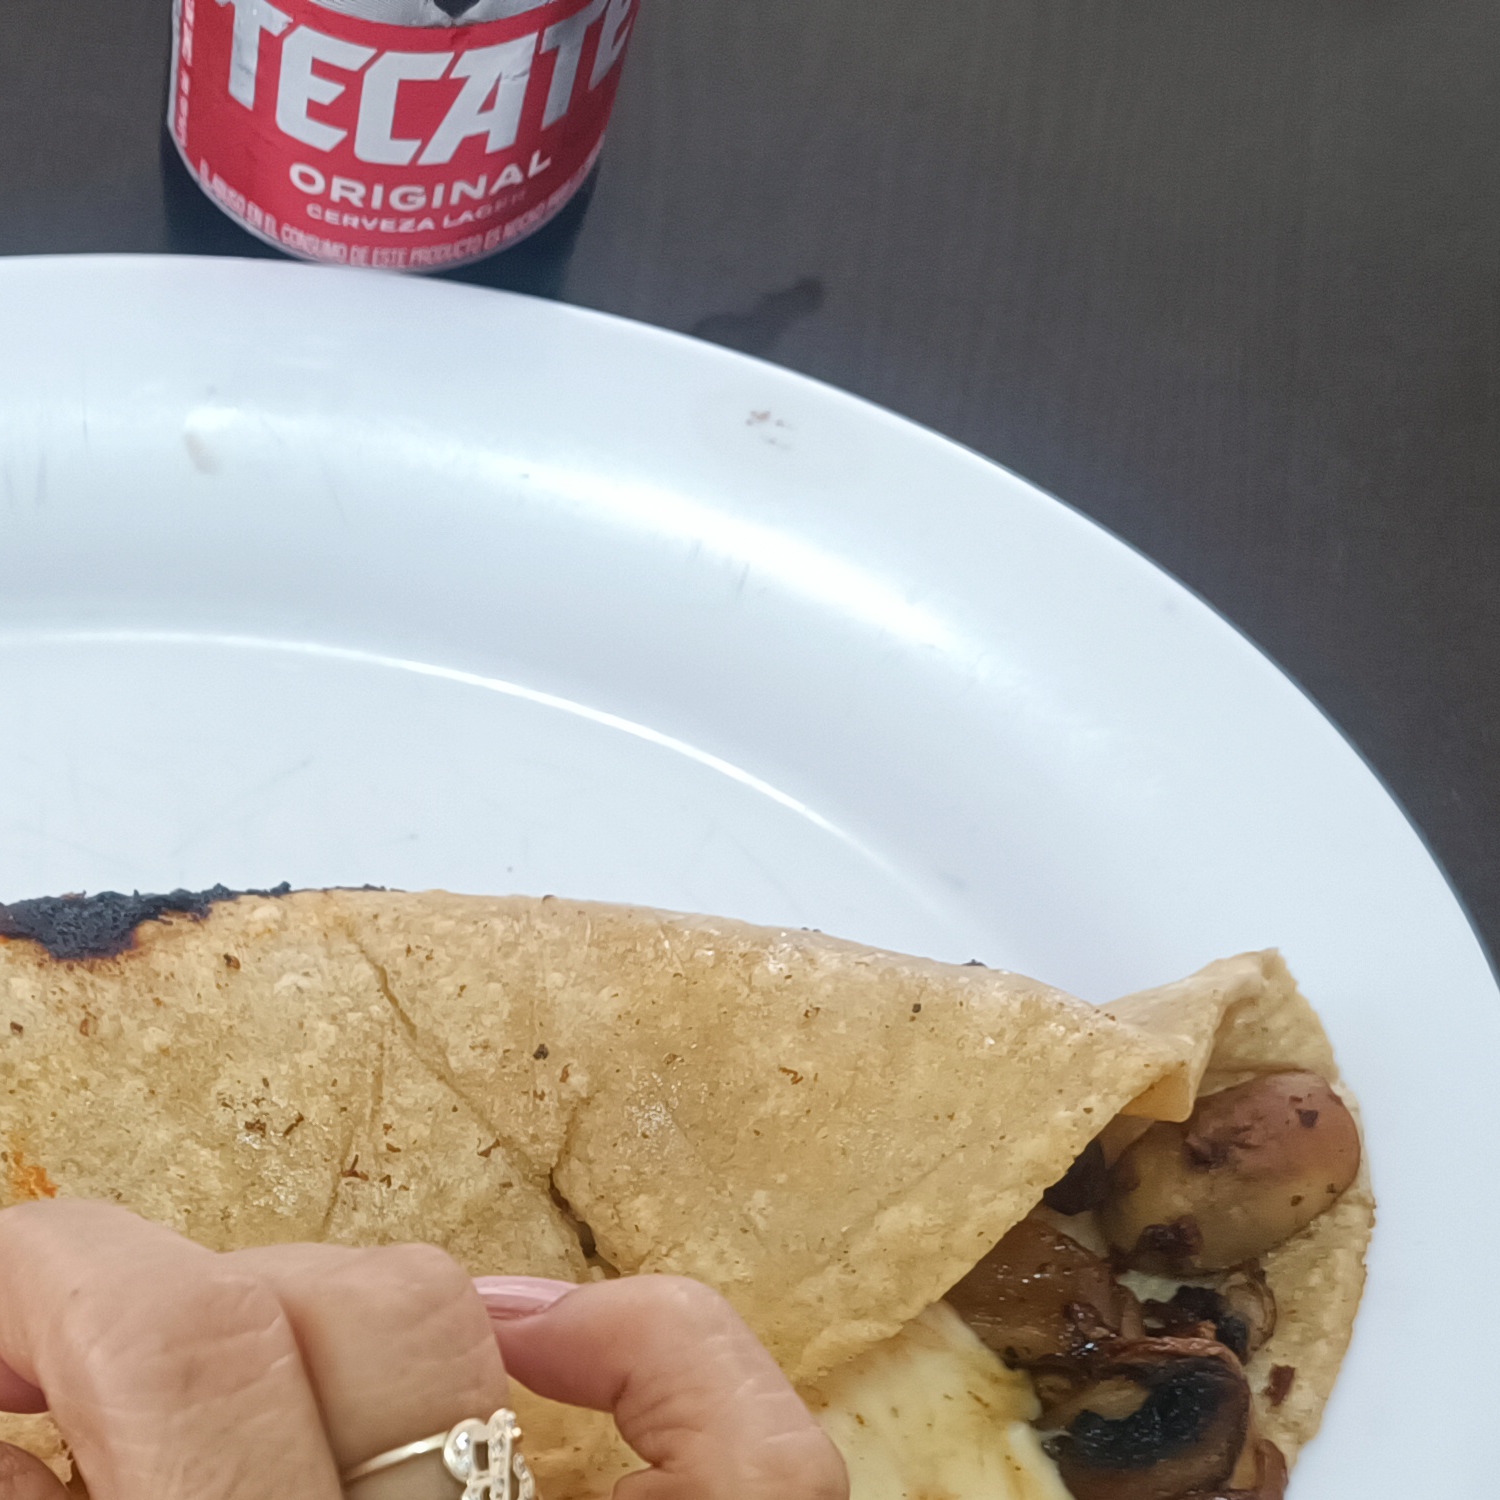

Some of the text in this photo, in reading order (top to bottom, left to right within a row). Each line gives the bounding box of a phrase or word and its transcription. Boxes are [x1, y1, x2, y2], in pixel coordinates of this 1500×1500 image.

[214, 0, 635, 166] TECATE
[289, 149, 552, 212] ORIGINAL
[306, 203, 435, 234] CERVEZA
